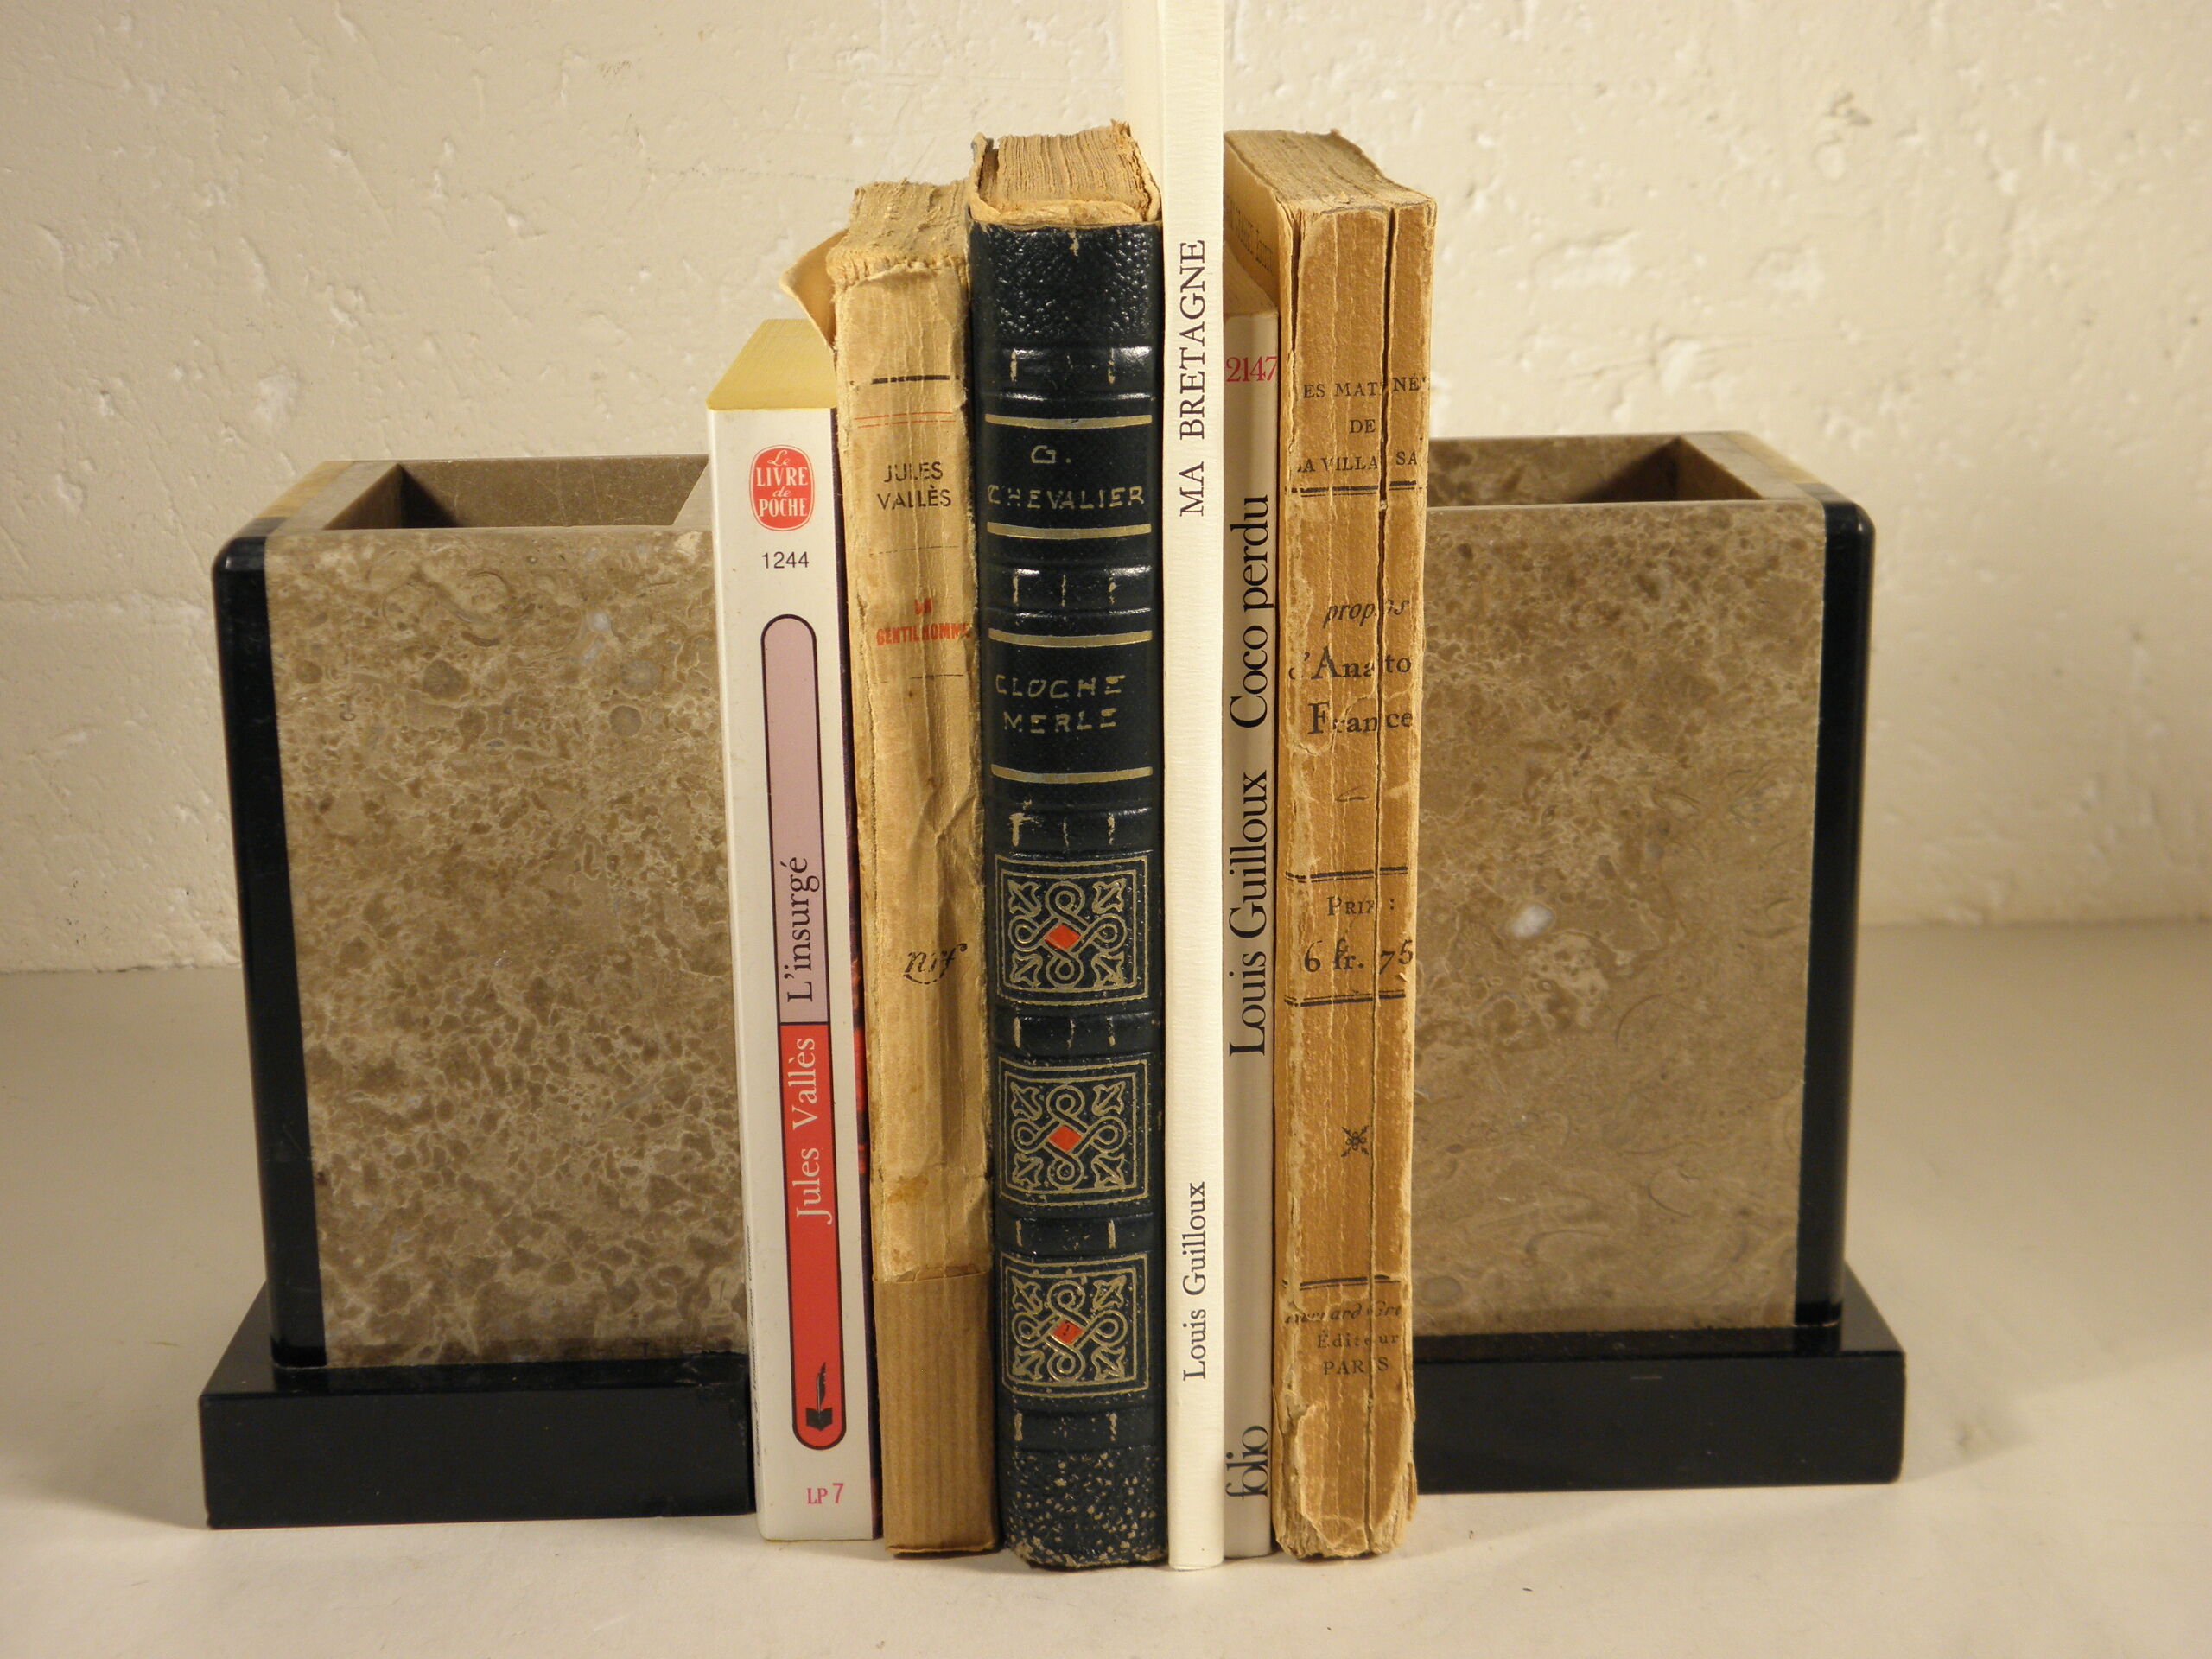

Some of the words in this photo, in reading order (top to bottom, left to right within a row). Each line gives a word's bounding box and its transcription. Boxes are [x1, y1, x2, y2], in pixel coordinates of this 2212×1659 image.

[1179, 239, 1206, 441] BRETAGNE
[1225, 355, 1277, 382] 2147
[1349, 418, 1376, 434] DE
[767, 449, 790, 466] Le
[1030, 444, 1071, 465] G.
[1298, 459, 1315, 473] A
[1320, 455, 1378, 471] VILLA
[756, 467, 809, 486] LIVRE
[884, 461, 944, 482] JULES
[772, 486, 791, 498] de
[877, 485, 951, 510] VALLÈS
[988, 482, 1145, 510] CHEVALIER
[1179, 461, 1205, 517] MA
[758, 498, 808, 517] POCHE
[761, 551, 809, 569] 1244
[1230, 494, 1274, 613] perdu
[995, 673, 1125, 698] CLOCHE
[1230, 625, 1268, 728] Coco
[1002, 708, 1117, 734] MERLE
[1307, 702, 1413, 734] France
[1229, 769, 1268, 938] Guilloux
[779, 856, 820, 1002] L'insurgé
[1304, 939, 1322, 973] 6
[1332, 938, 1365, 970] fr.
[1379, 939, 1414, 975] 75
[1229, 950, 1266, 1057] Louis
[788, 1038, 818, 1130] Vallès
[791, 1147, 832, 1225] Jules
[1181, 1181, 1206, 1296] Guilloux
[1182, 1308, 1207, 1382] Louis
[1323, 1357, 1389, 1376] PARS
[1225, 1425, 1268, 1500] folio
[807, 1487, 829, 1504] LP
[832, 1483, 844, 1503] 7
